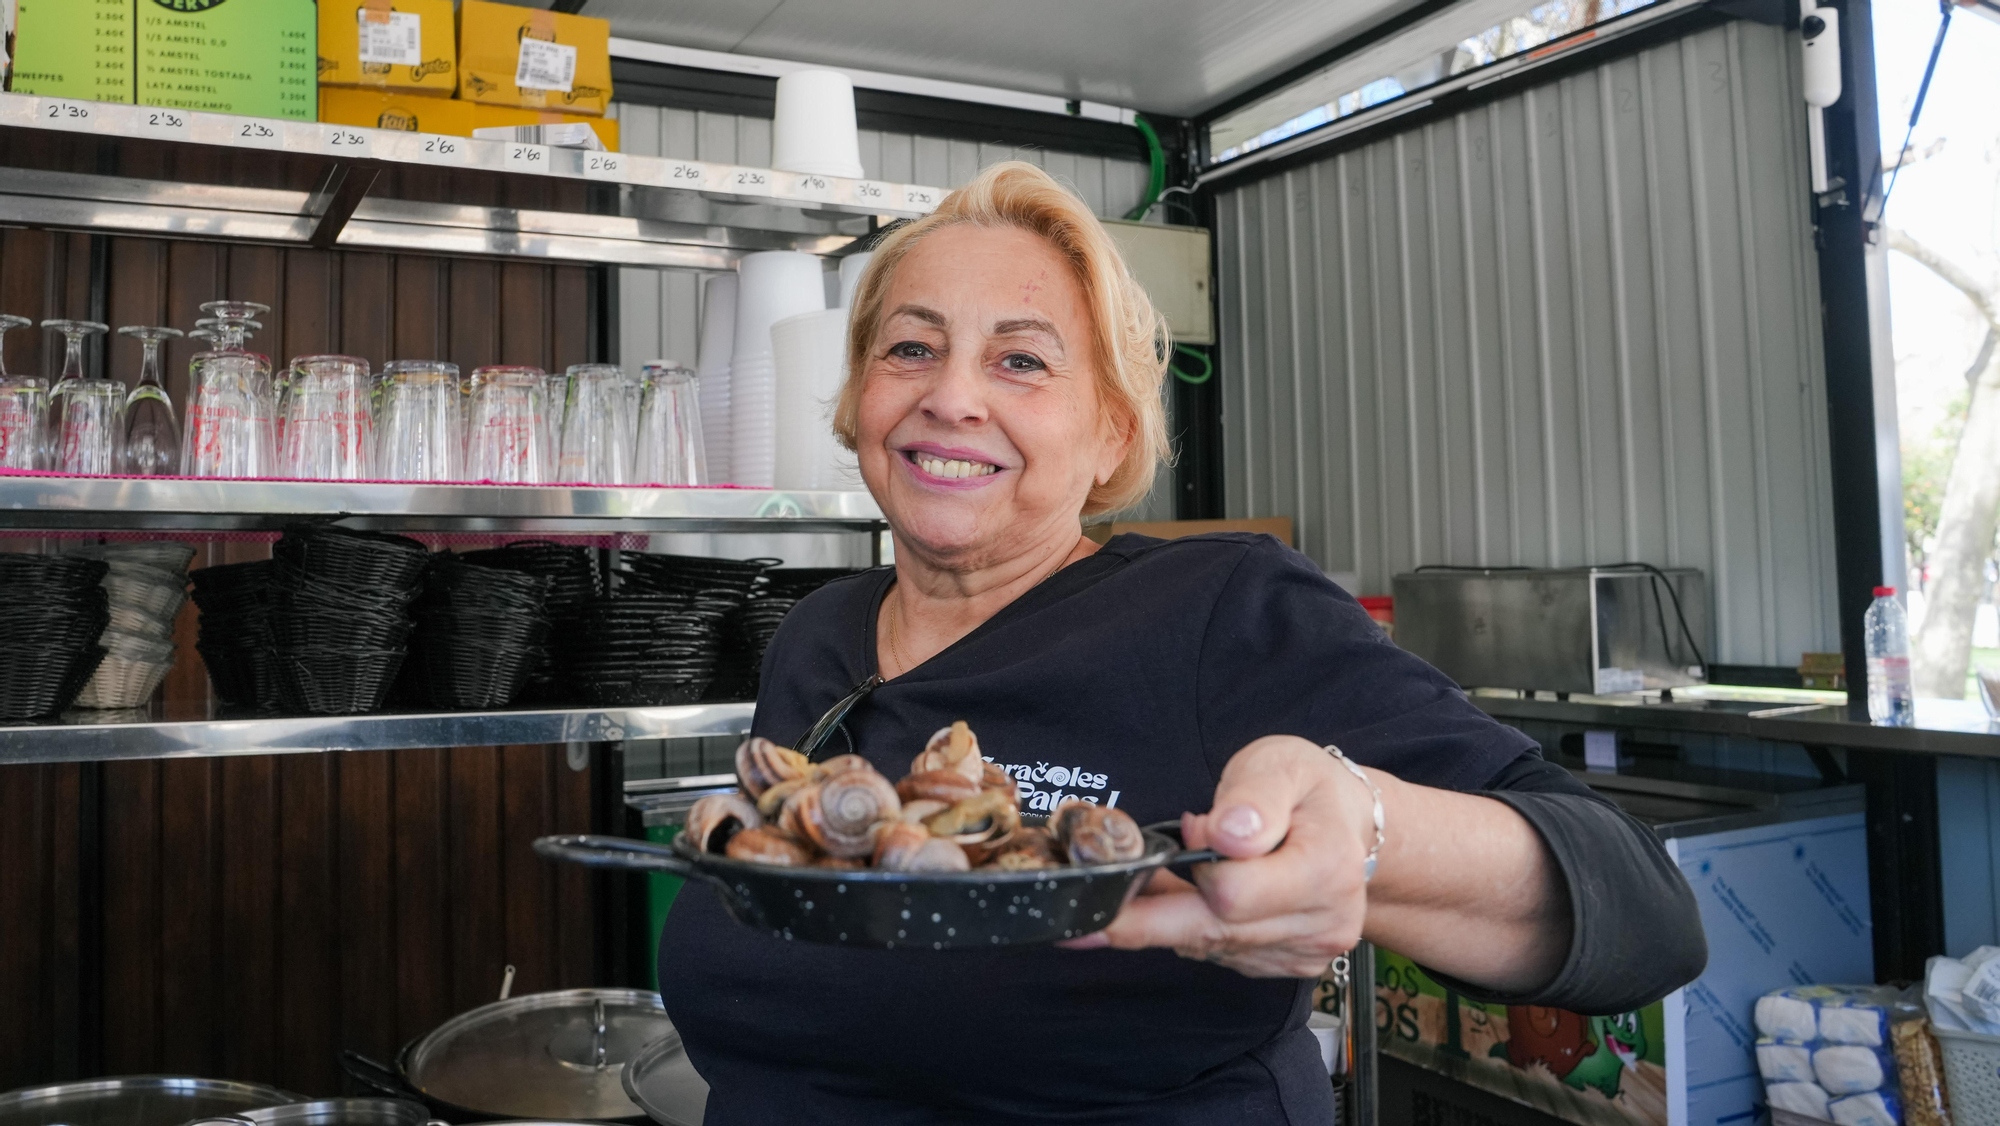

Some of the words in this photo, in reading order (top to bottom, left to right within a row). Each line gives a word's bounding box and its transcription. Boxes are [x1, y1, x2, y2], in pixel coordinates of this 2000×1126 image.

[166, 19, 207, 30] AMSTEL
[166, 35, 207, 46] AMSTEL
[159, 50, 200, 61] AMSTEL
[159, 66, 200, 77] AMSTEL
[204, 70, 253, 81] TOSTADA
[146, 81, 172, 91] LATA
[177, 84, 218, 95] AMSTEL
[166, 99, 233, 112] CRUZCAMPO
[981, 756, 1109, 790] racoles
